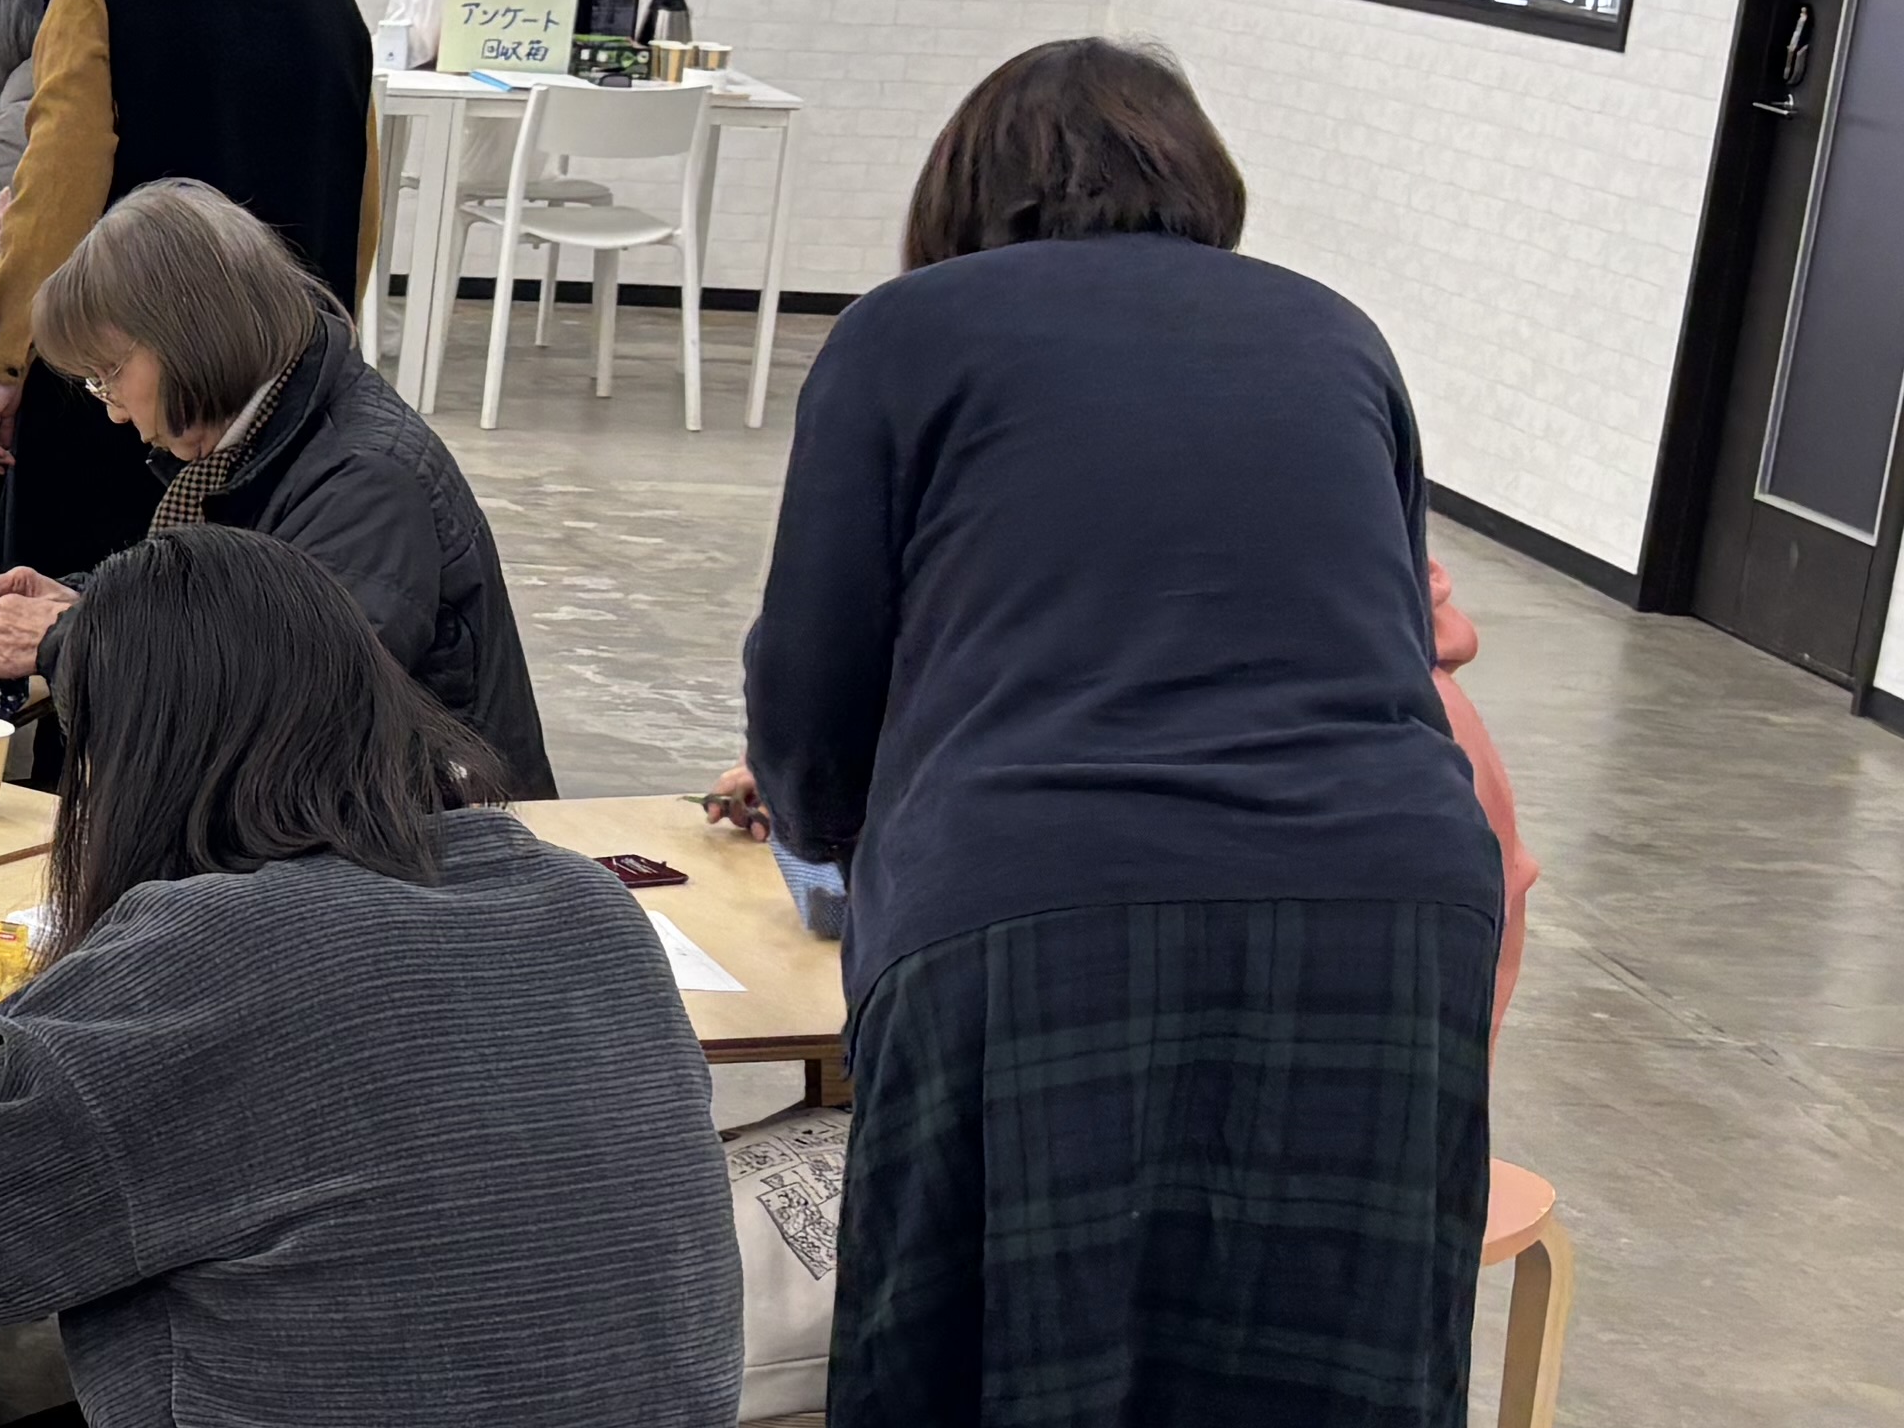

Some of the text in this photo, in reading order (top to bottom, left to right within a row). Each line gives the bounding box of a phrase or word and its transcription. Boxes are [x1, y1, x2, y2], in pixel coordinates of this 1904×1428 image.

[459, 1, 560, 32] アンケート
[482, 38, 549, 63] 回収箱
